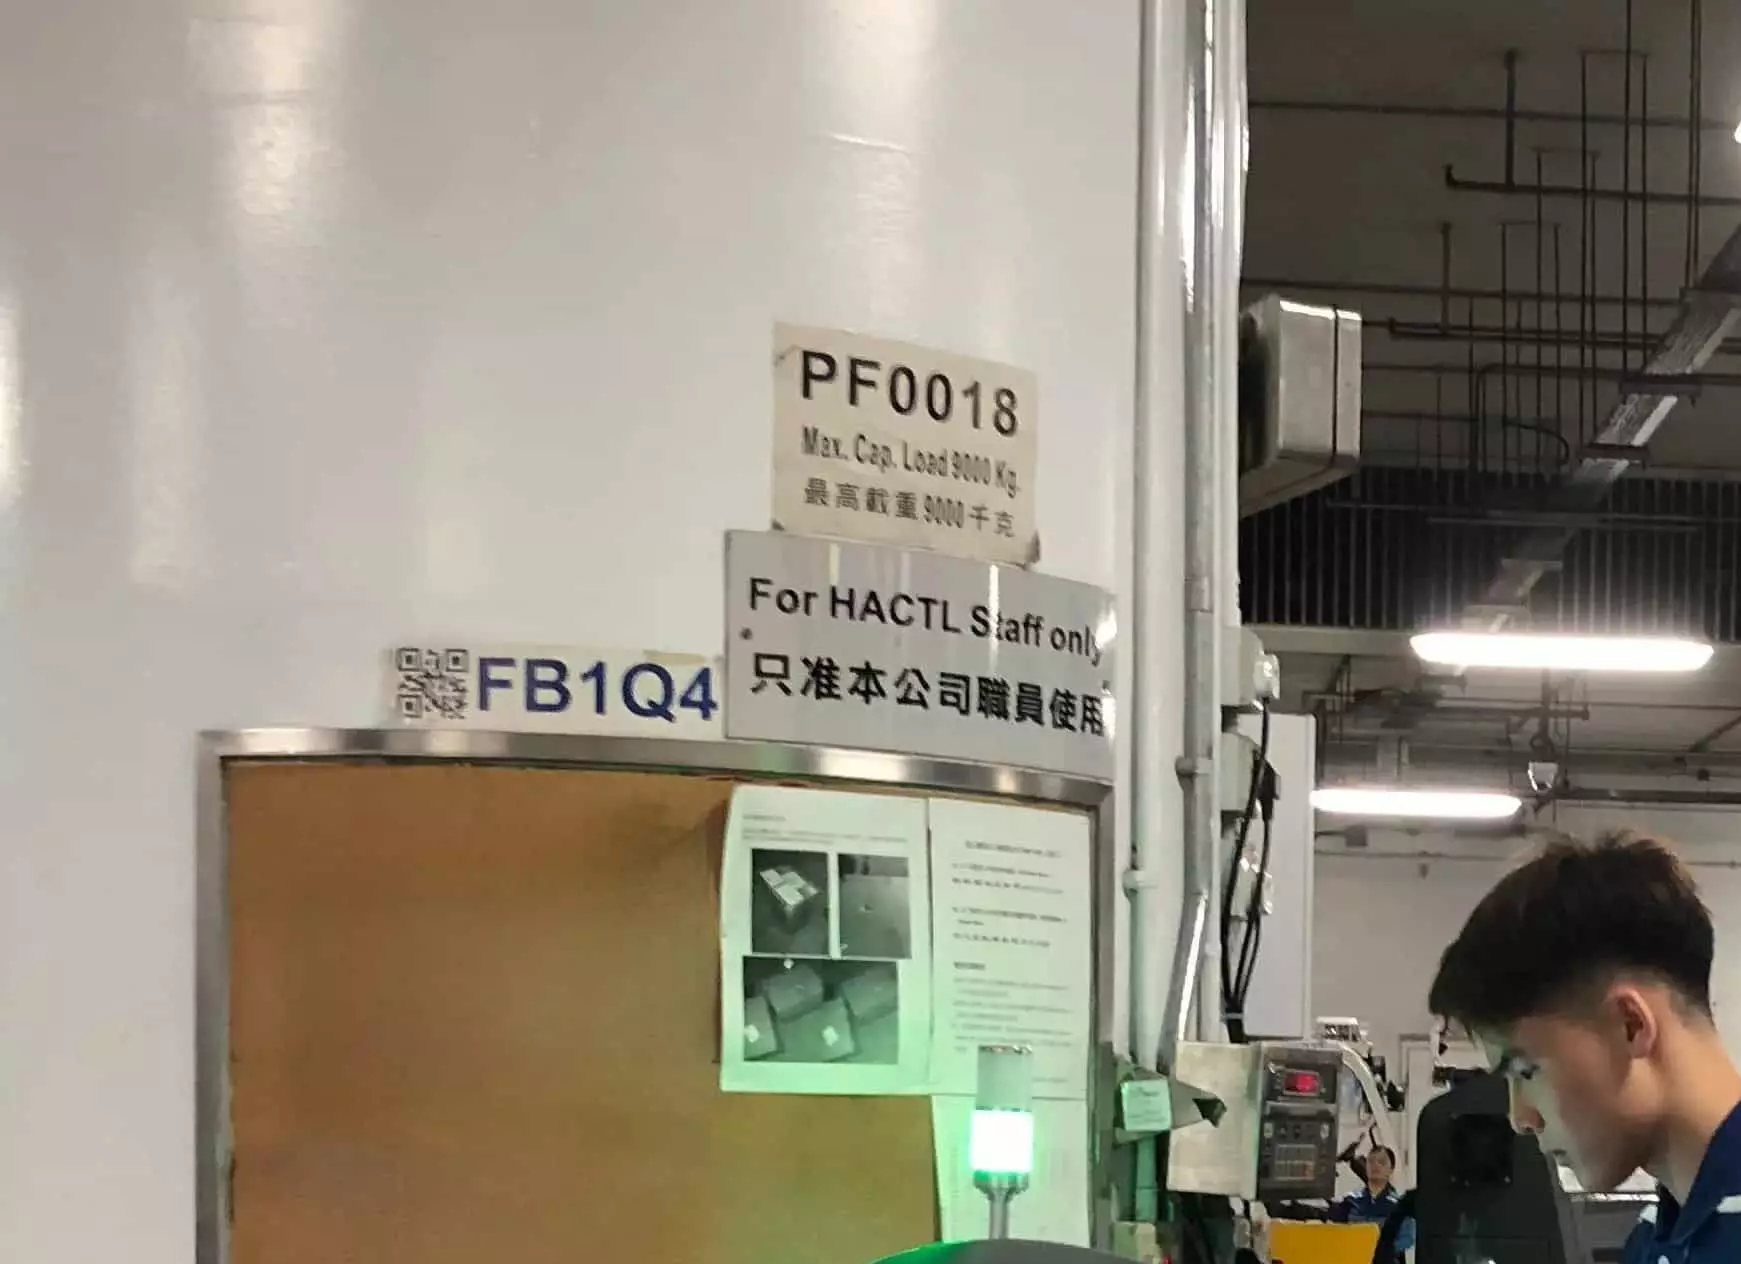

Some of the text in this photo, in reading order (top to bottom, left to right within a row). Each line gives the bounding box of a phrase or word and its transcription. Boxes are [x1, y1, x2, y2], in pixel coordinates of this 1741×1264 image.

[802, 349, 1018, 438] PF0018
[803, 425, 849, 461] Max.
[855, 433, 898, 473] Cap.
[902, 440, 949, 478] Load
[749, 576, 819, 616] For
[829, 585, 962, 634] HACTL
[970, 604, 1044, 648] Staff
[476, 656, 718, 723] FB1Q4
[750, 652, 1106, 737] 只准本公司職員使用
